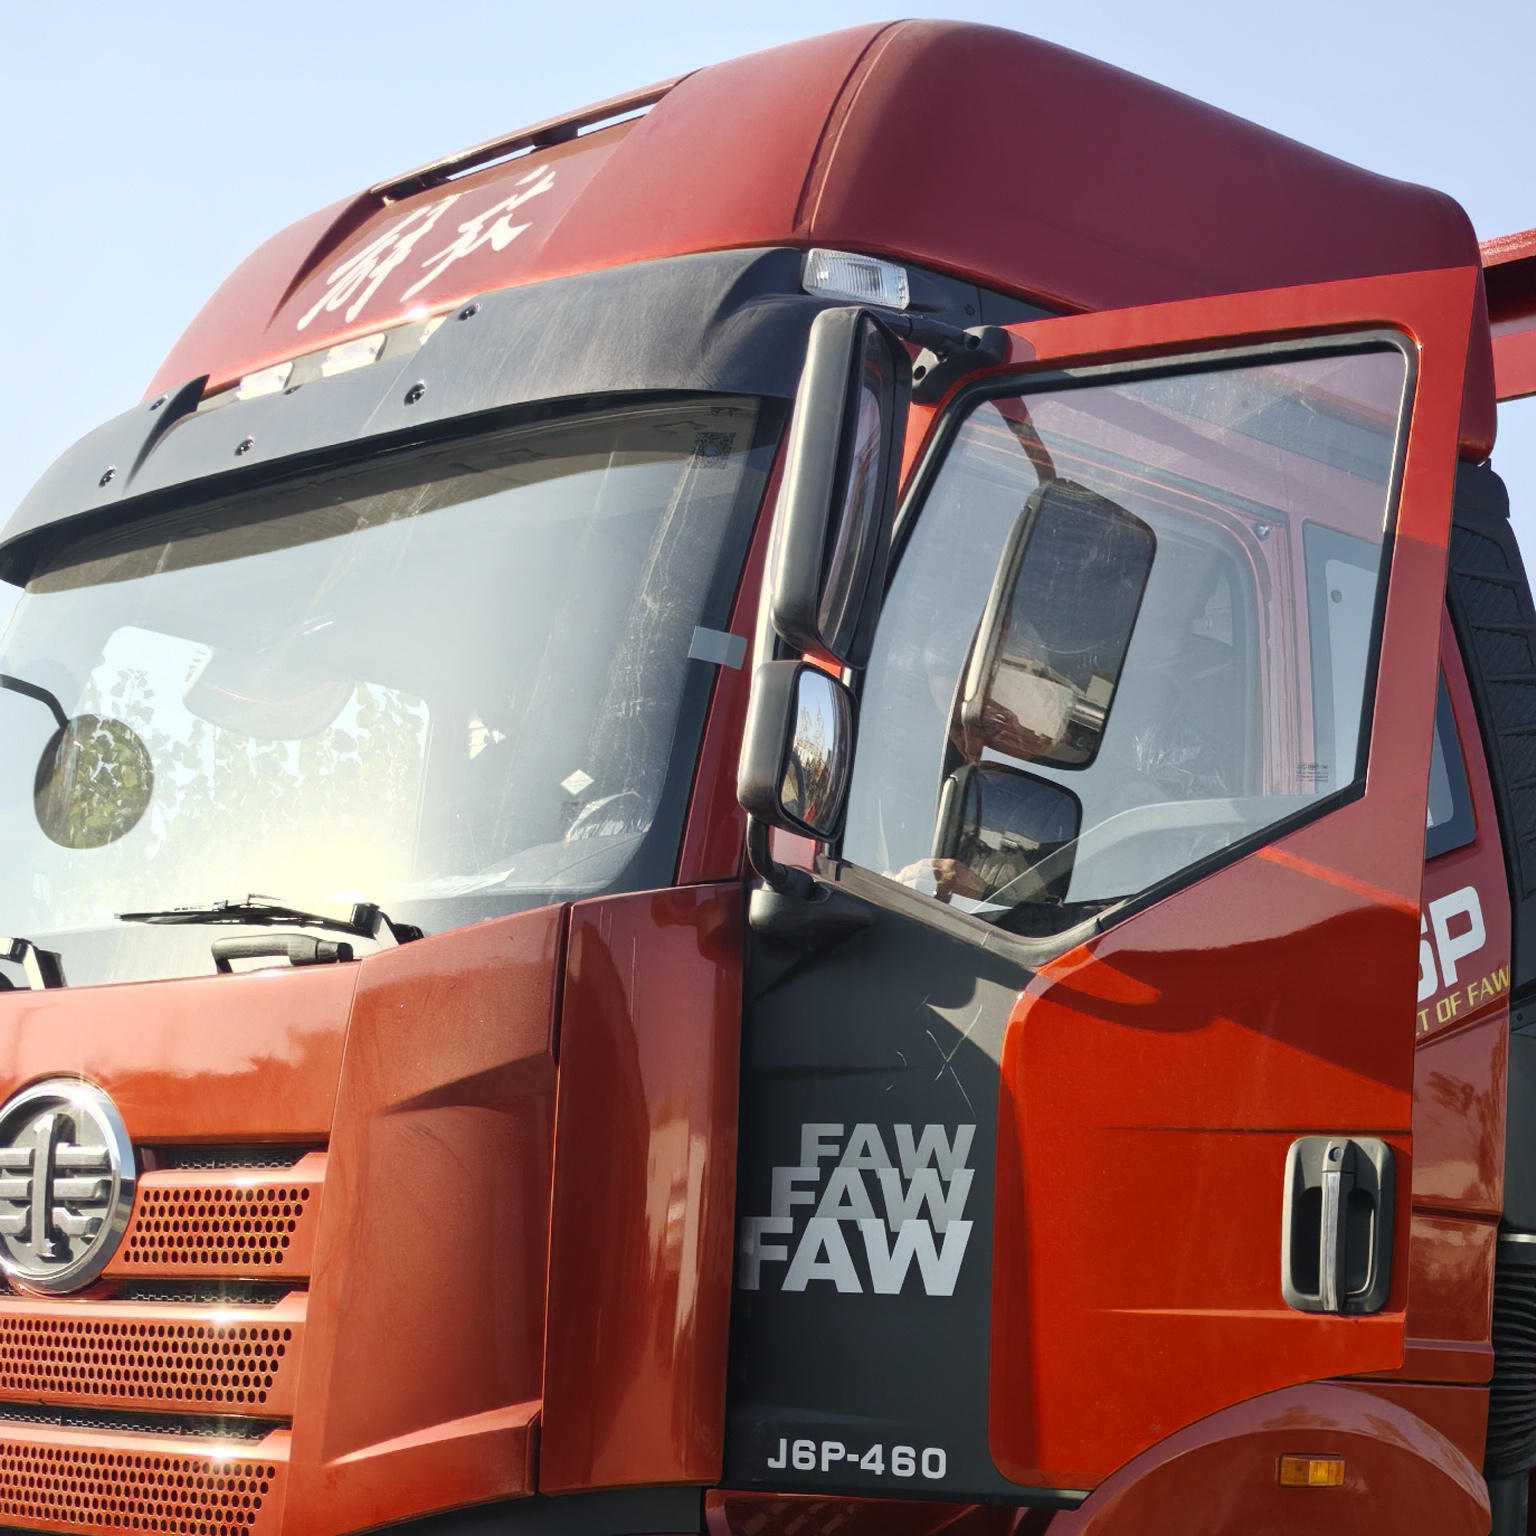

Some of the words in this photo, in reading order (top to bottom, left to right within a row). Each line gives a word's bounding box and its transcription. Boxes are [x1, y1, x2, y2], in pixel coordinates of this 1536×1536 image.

[1415, 1007, 1430, 1037] T
[1435, 991, 1462, 1024] OF
[1466, 963, 1509, 1007] FAW
[800, 1122, 977, 1182] FAW
[770, 1166, 976, 1234] FAW
[738, 1216, 975, 1297] FAW
[767, 1438, 947, 1480] J6P-460
